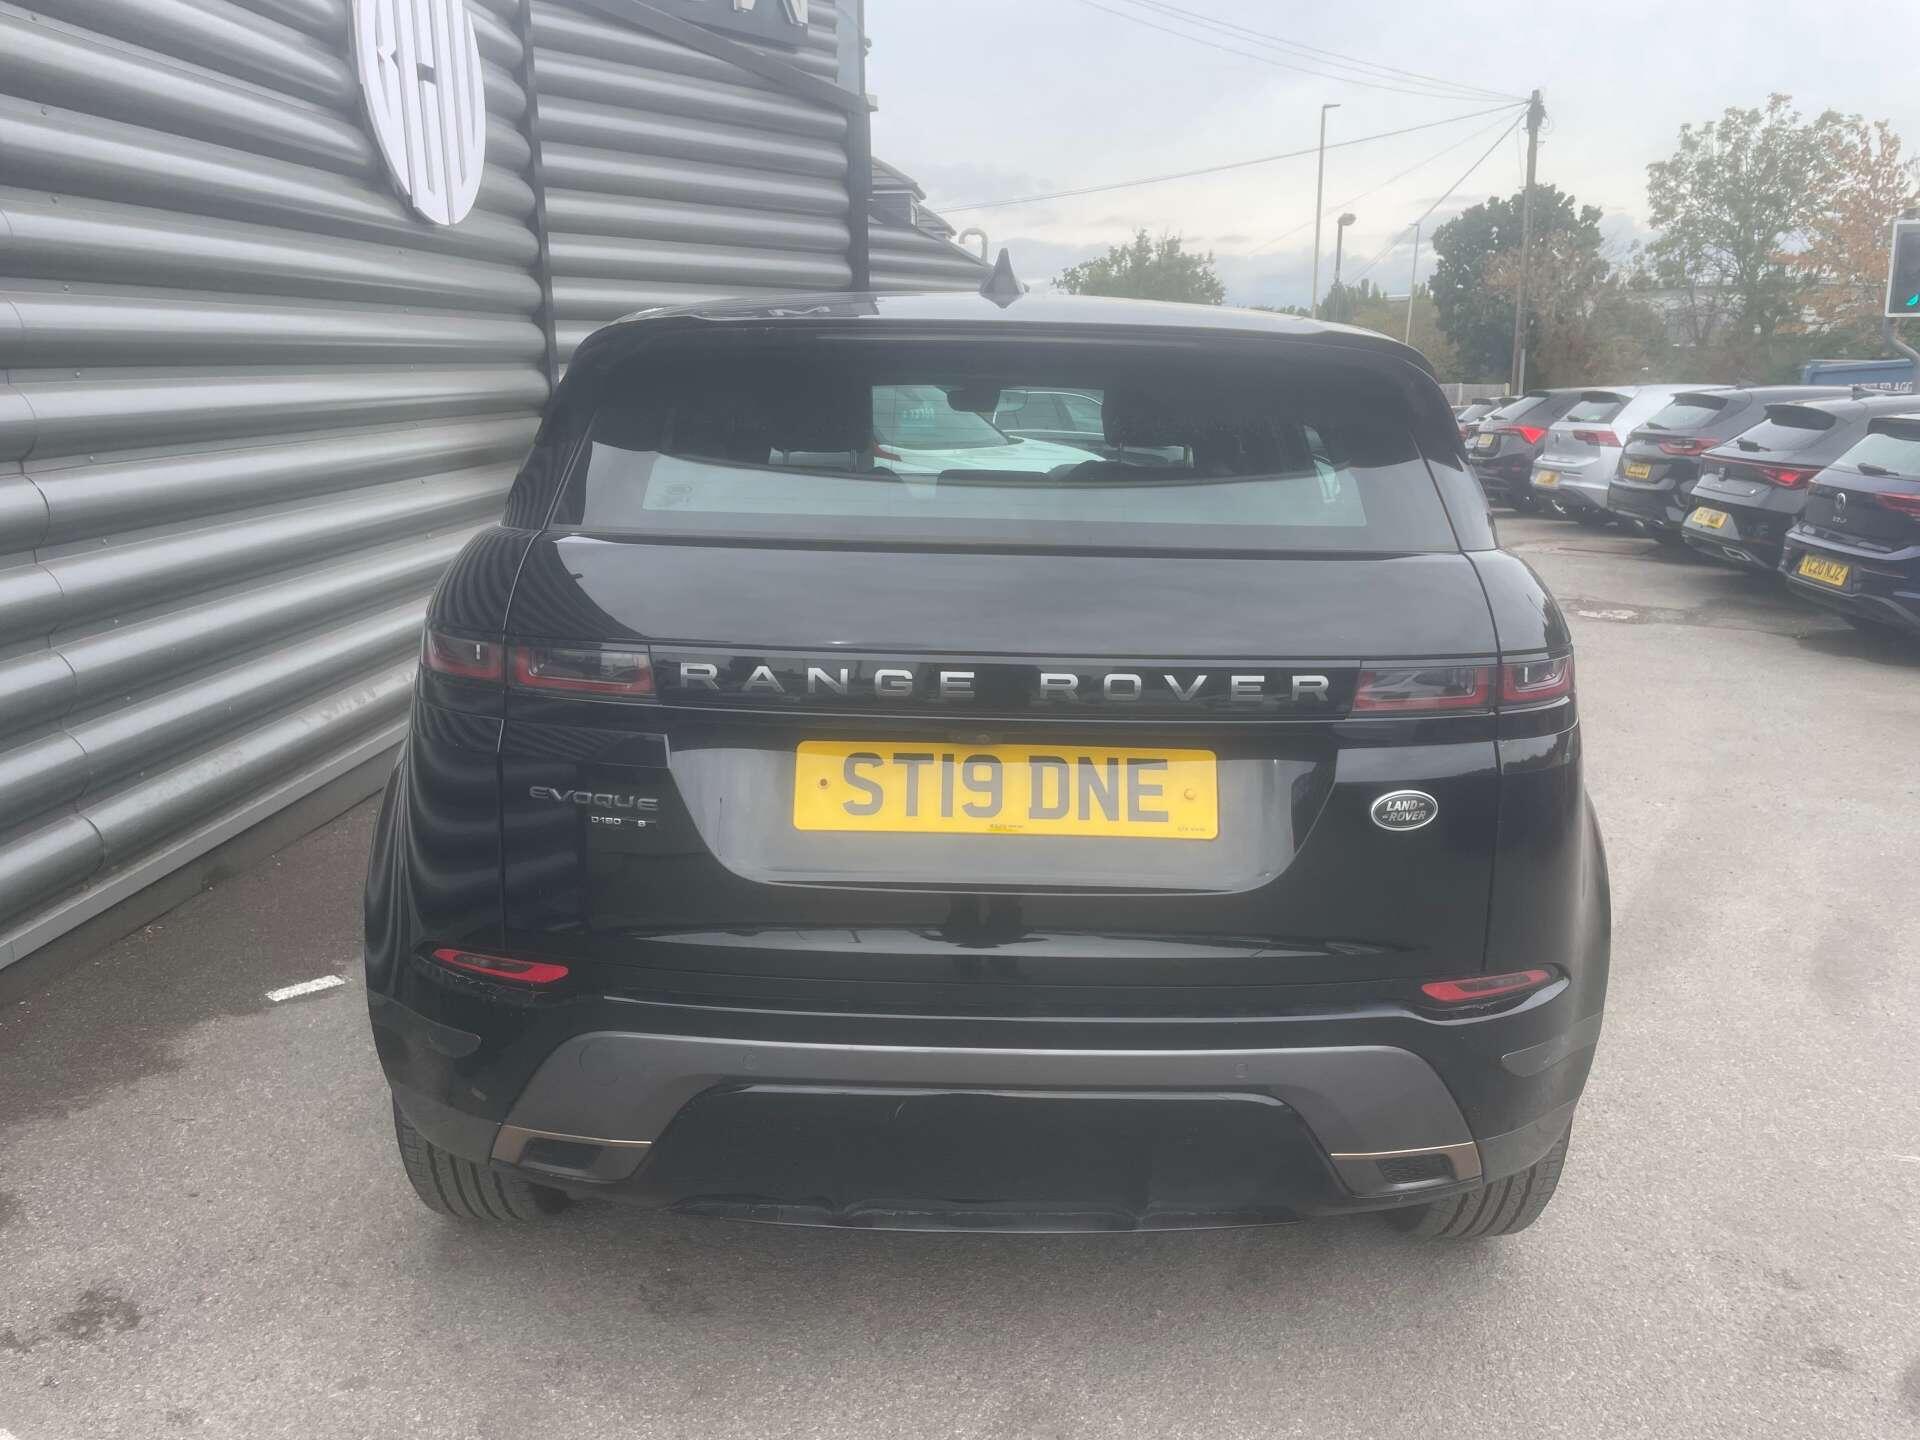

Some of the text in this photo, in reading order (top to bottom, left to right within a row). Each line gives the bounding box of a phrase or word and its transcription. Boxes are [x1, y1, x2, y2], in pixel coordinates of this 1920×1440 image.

[679, 662, 1329, 702] RANGE ROVER
[529, 786, 659, 811] EVOQUE
[842, 752, 1169, 823] ST19 DNE
